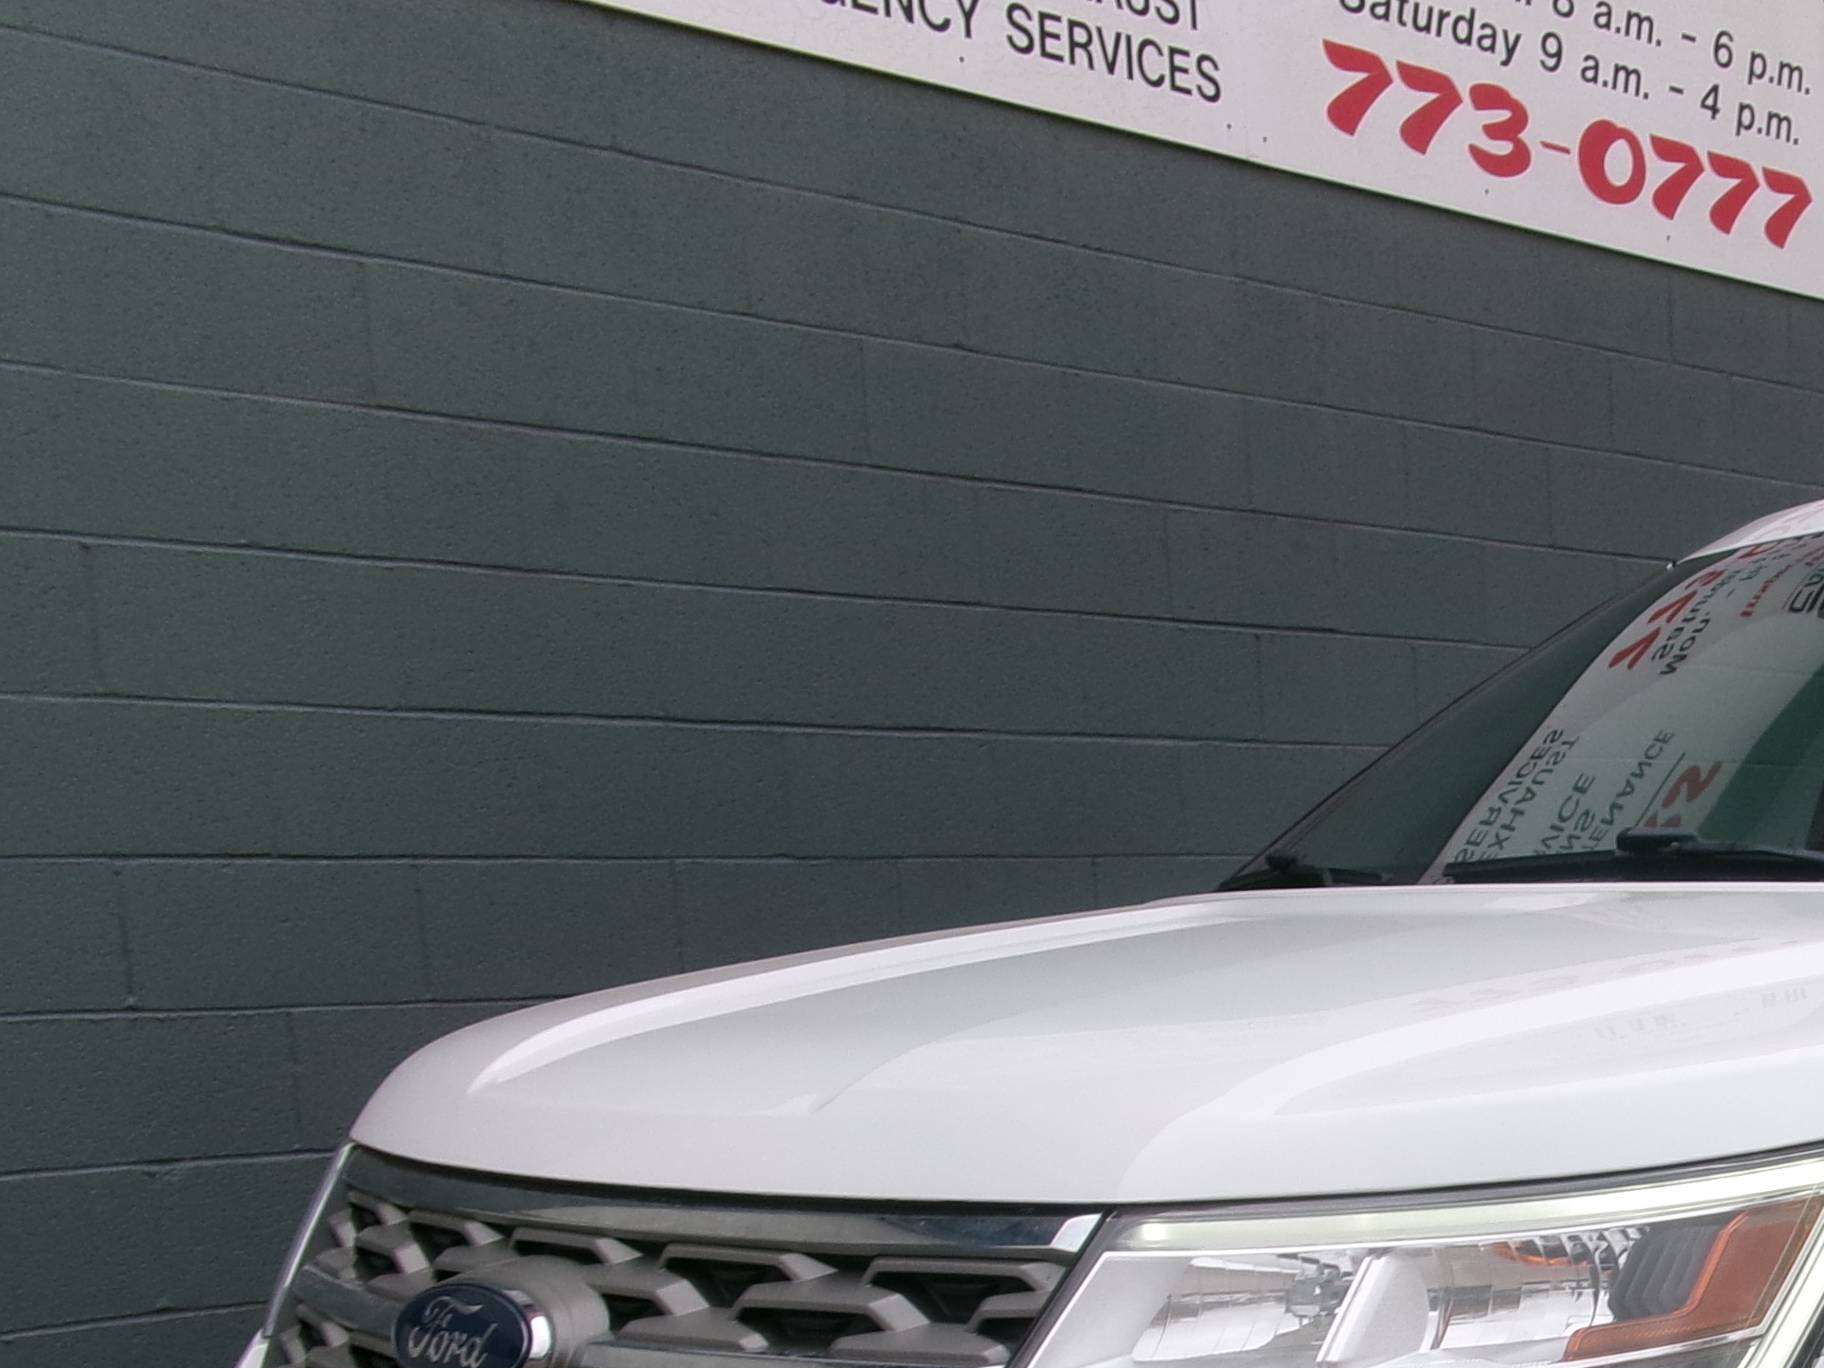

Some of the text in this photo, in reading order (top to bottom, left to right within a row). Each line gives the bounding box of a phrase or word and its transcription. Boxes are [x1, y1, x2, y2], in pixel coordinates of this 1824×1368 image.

[1006, 2, 1222, 102] SERVICES
[1539, 32, 1563, 72] 9
[1580, 54, 1650, 100] a.m.
[1700, 84, 1721, 120] 4
[1736, 102, 1800, 146] p.m.
[1593, 1, 1662, 46] a.m.
[1713, 30, 1734, 68] 6
[1748, 48, 1811, 94] p.m.
[1322, 39, 1813, 249] 773-0777
